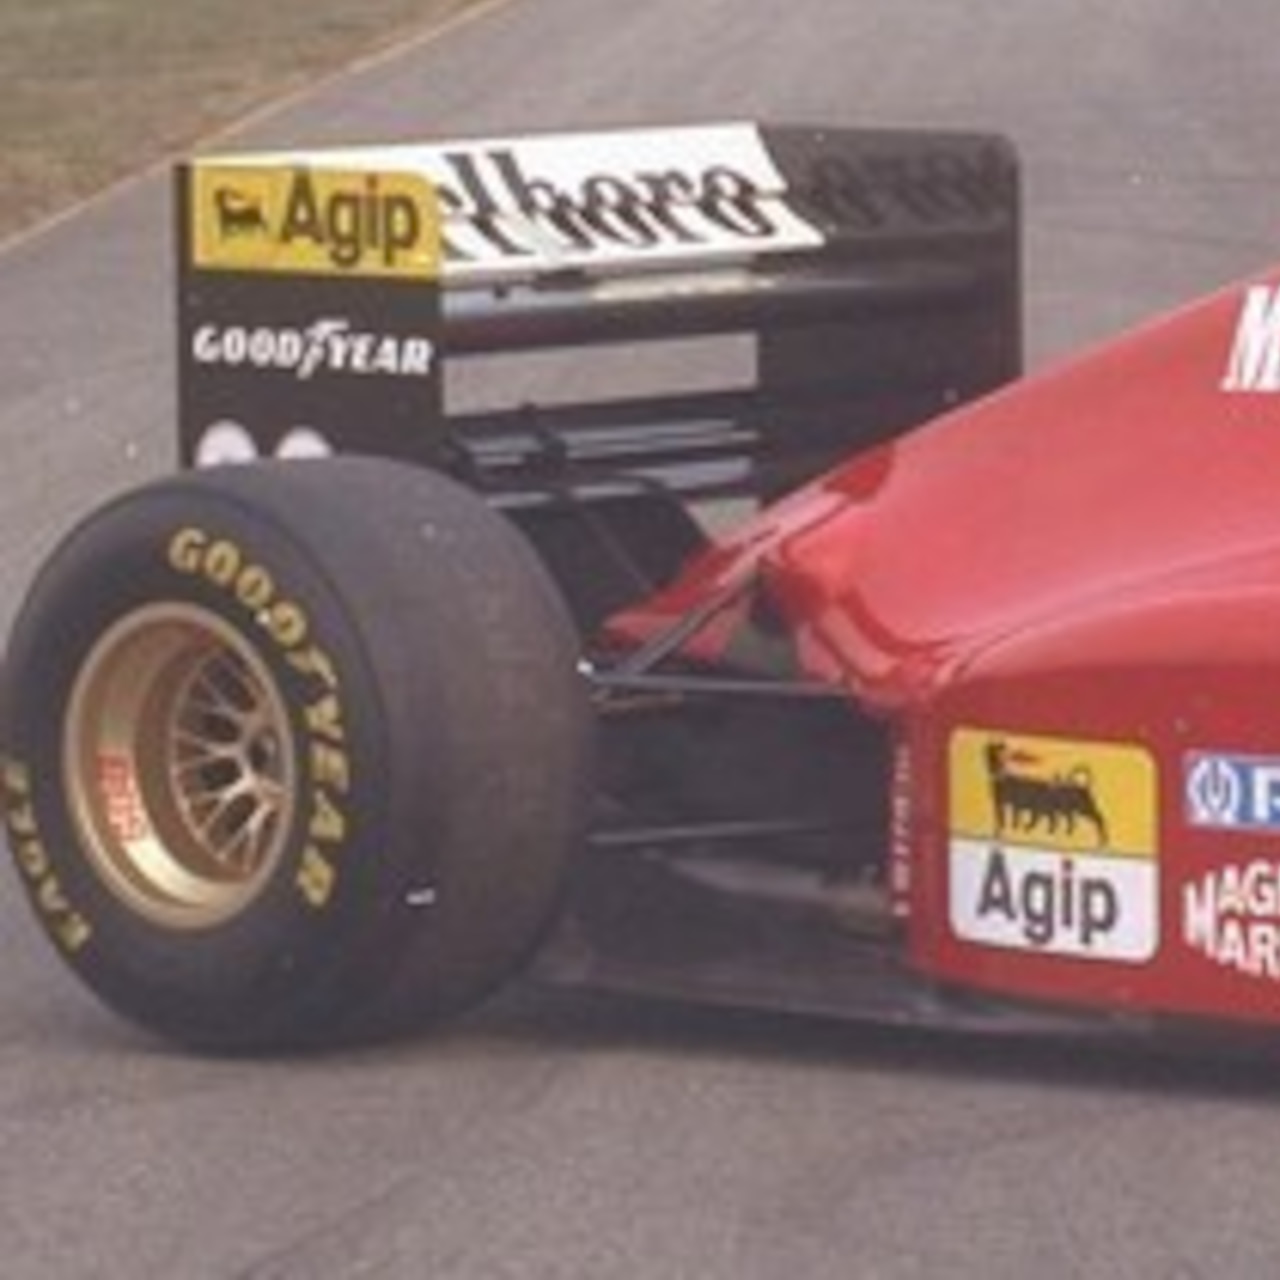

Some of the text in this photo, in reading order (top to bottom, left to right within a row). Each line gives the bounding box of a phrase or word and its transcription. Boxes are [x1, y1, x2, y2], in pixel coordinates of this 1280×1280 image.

[280, 166, 420, 267] Agip
[192, 317, 434, 380] GOODYEAR
[975, 851, 1119, 946] Agip
